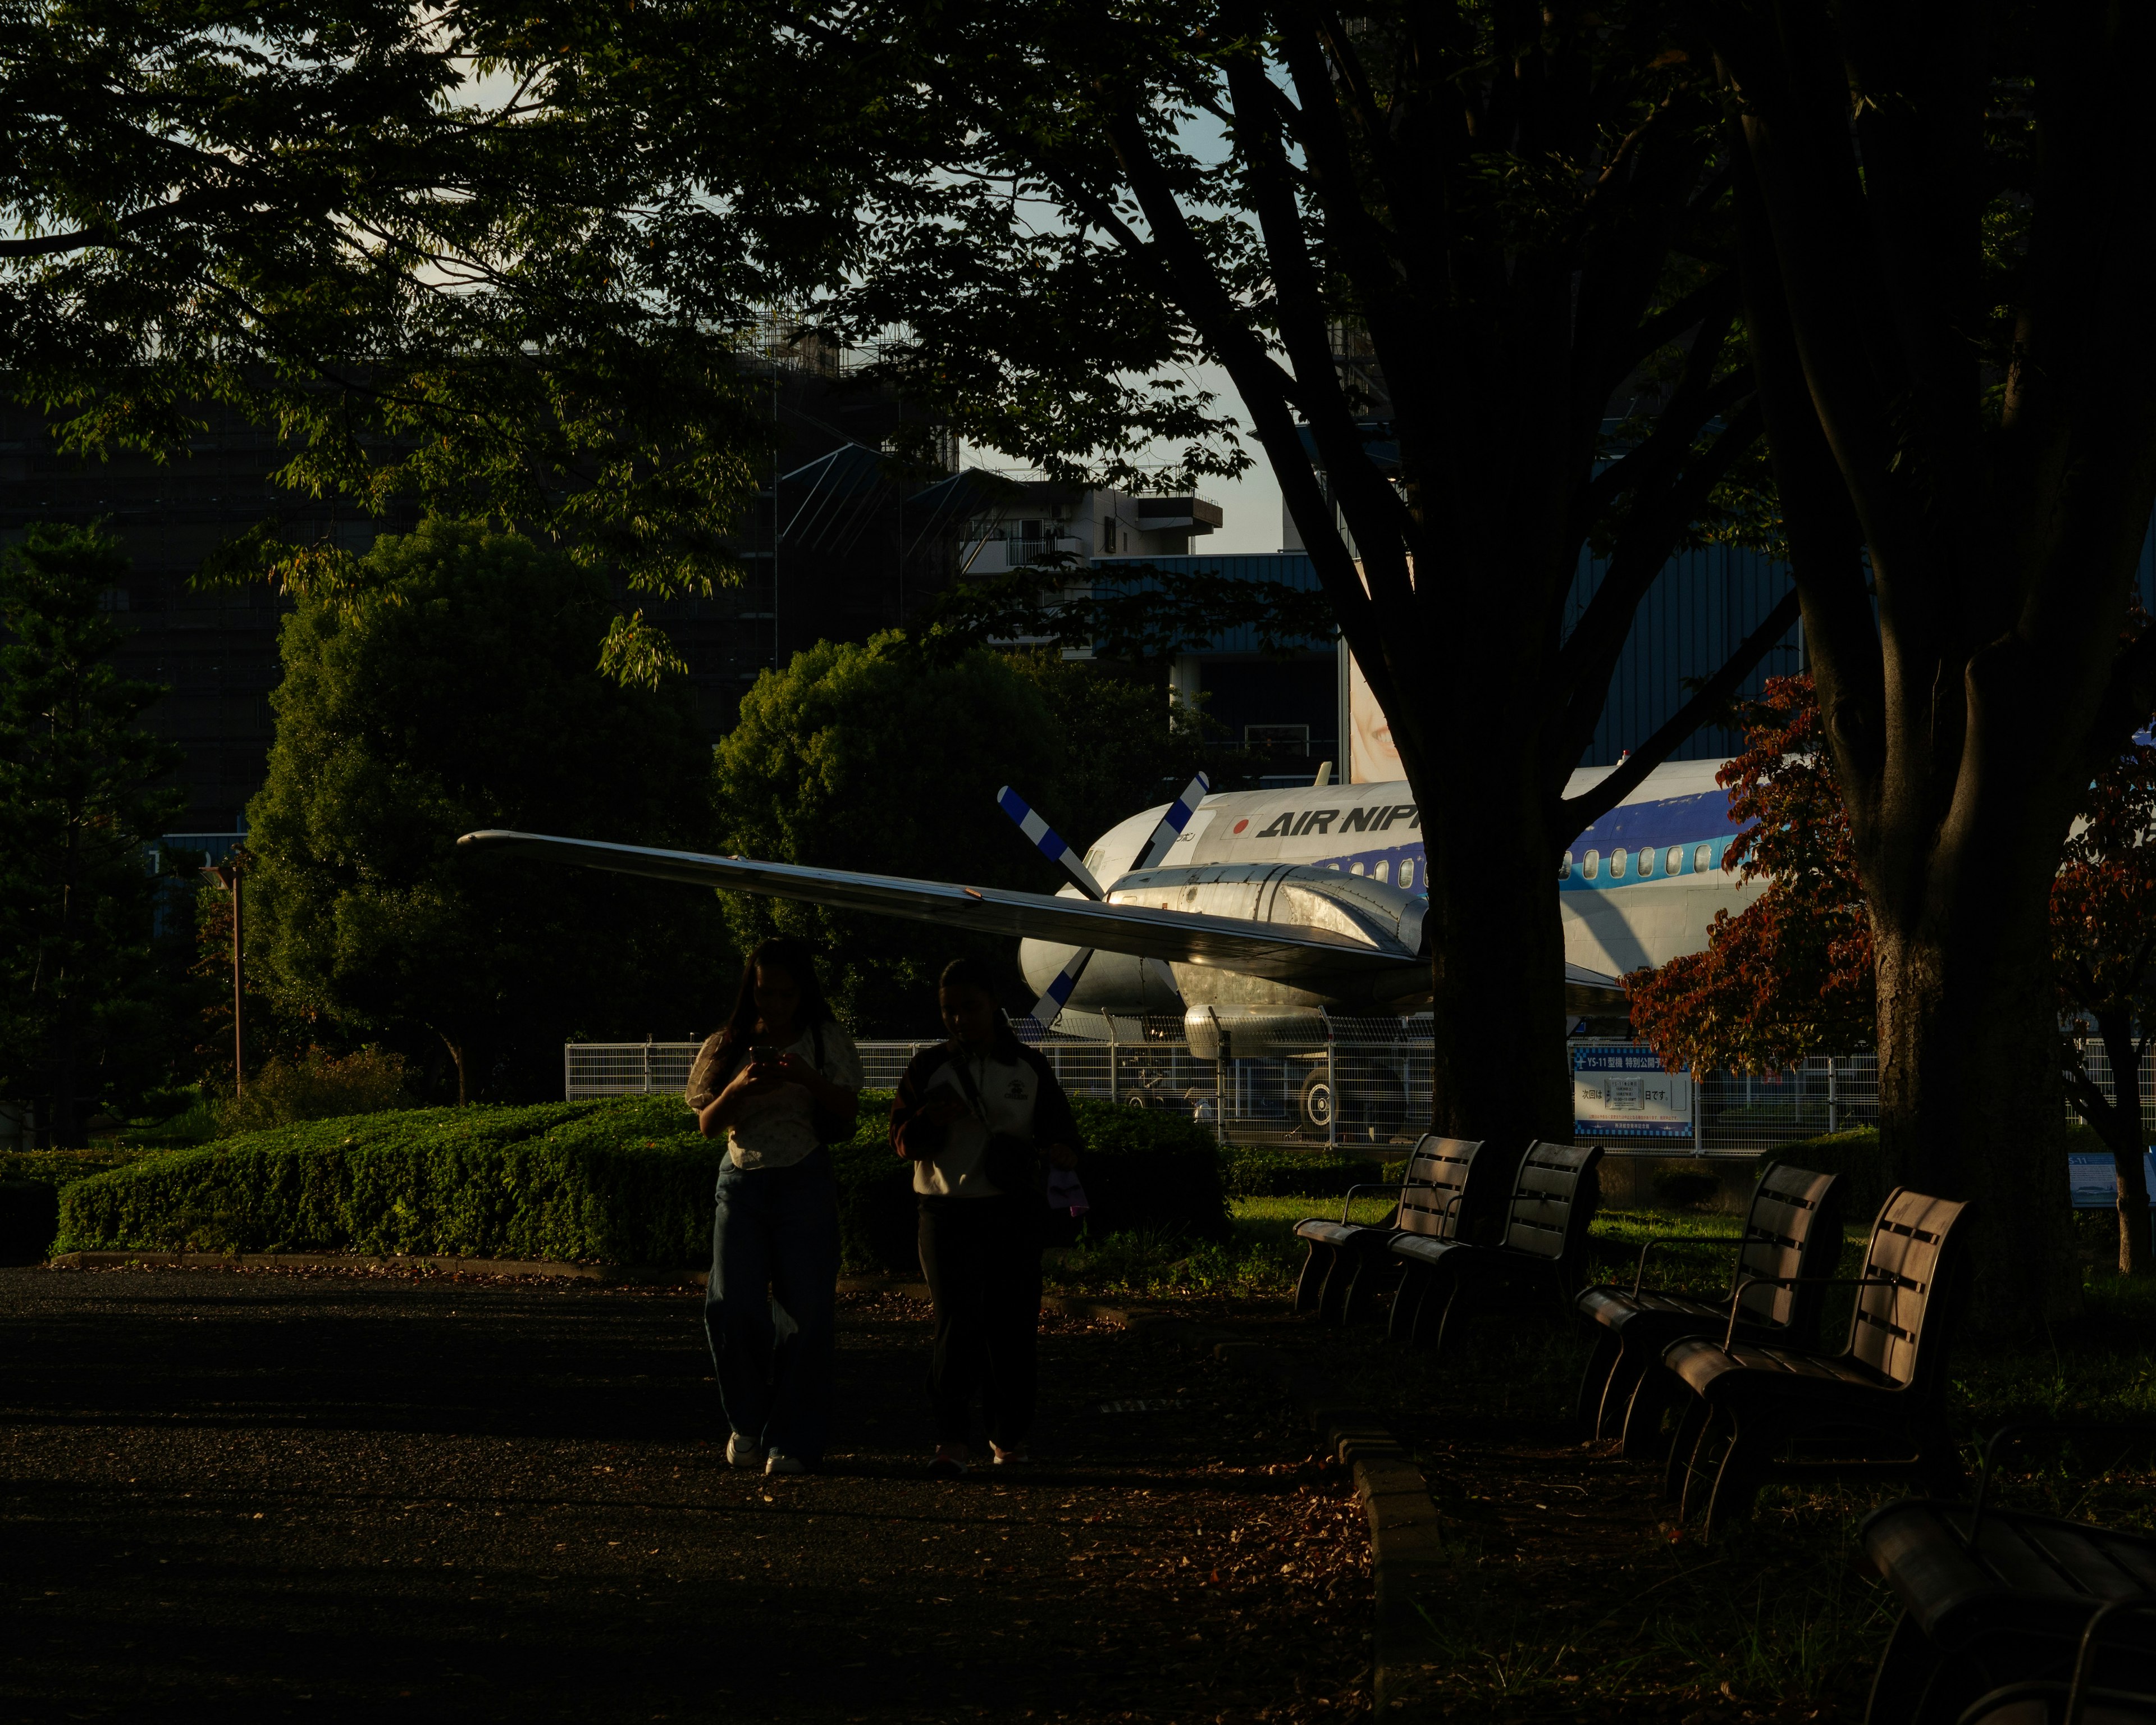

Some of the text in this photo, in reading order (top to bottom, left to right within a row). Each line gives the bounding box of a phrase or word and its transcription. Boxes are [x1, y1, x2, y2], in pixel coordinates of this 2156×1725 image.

[1255, 809, 1340, 838] AIR
[1582, 1089, 1602, 1099] 次回は
